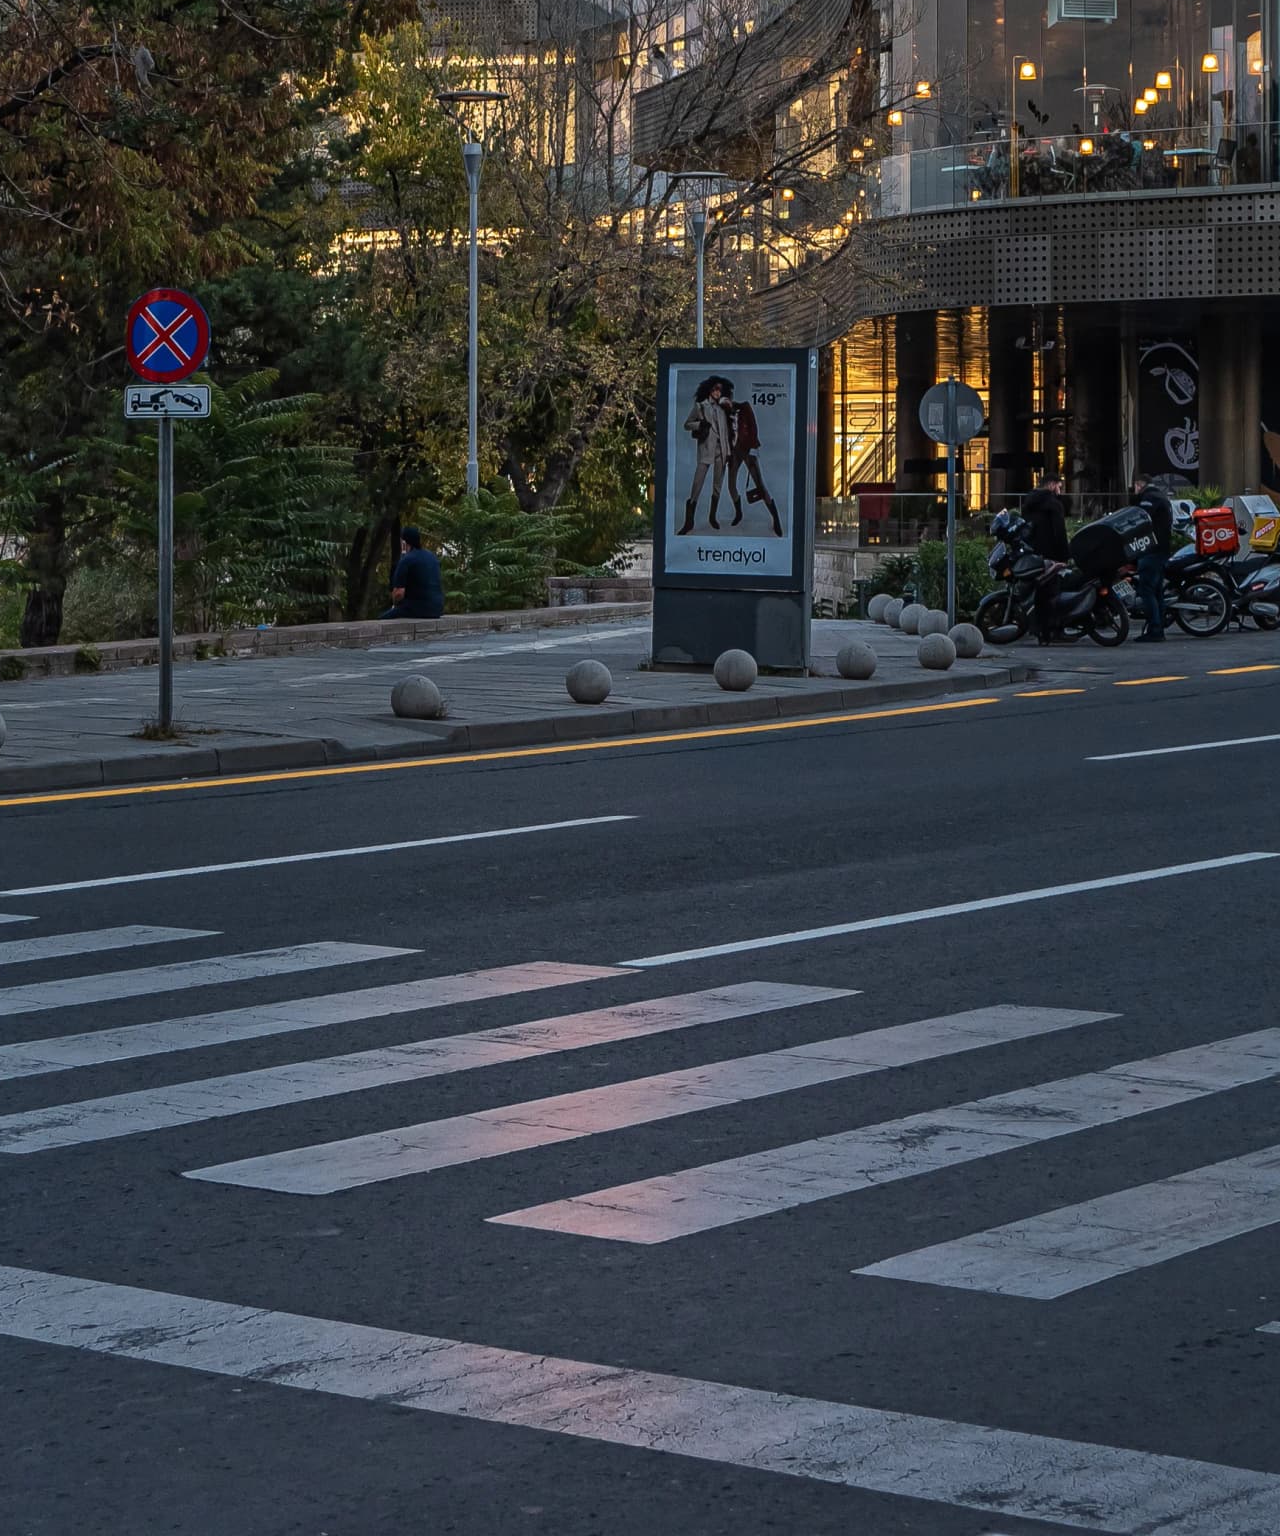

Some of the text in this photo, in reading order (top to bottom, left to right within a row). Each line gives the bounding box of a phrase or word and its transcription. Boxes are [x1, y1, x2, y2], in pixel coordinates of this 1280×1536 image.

[810, 355, 816, 368] 2
[751, 393, 776, 406] 149
[1129, 536, 1150, 552] vigo
[697, 546, 766, 567] trendyol
